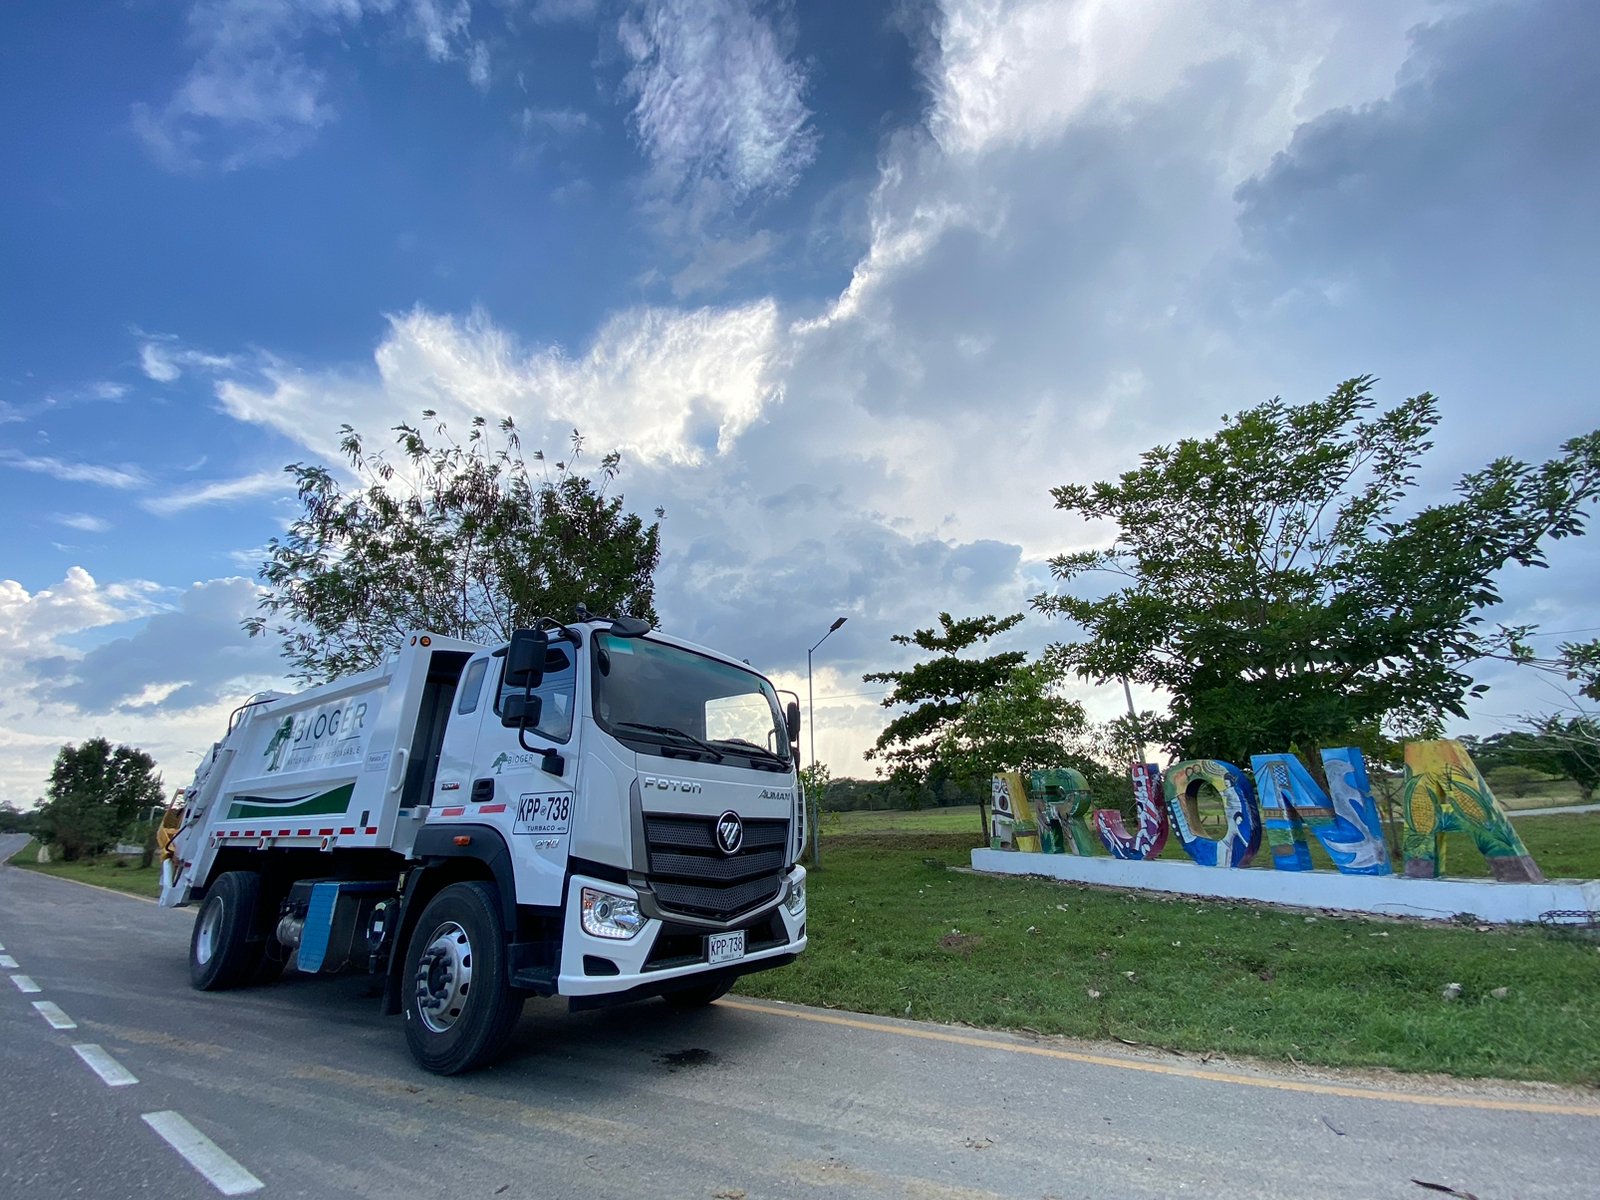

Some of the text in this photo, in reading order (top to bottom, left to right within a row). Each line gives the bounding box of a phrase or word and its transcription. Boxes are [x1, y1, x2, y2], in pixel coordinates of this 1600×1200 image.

[293, 702, 368, 744] BIOGER
[507, 753, 534, 765] BIOGER
[644, 776, 702, 794] FOTON
[758, 788, 791, 801] AUMAN
[517, 795, 570, 822] KPP 738
[990, 739, 1546, 883] ARJONA
